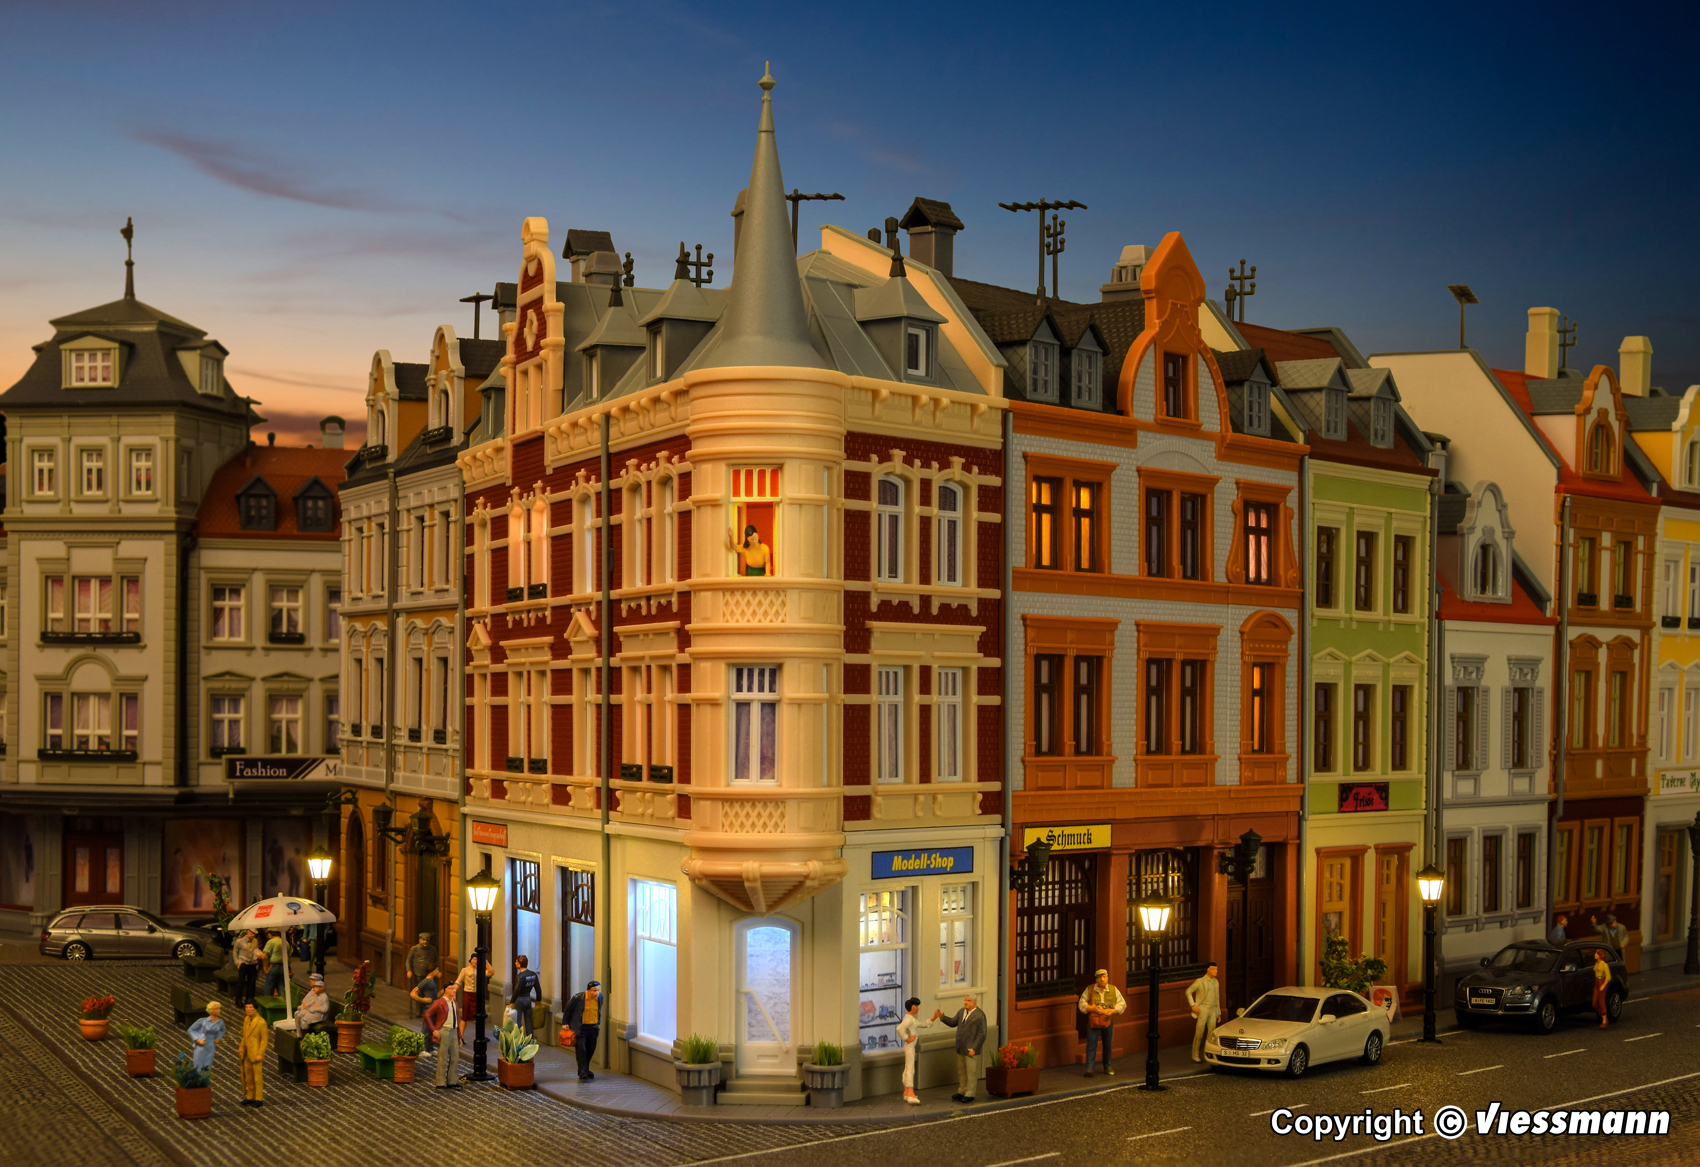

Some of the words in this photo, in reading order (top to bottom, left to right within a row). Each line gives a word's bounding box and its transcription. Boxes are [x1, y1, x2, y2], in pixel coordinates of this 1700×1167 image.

[235, 761, 287, 776] Fashion
[1661, 773, 1686, 788] Taverne
[1353, 792, 1374, 809] Frisör
[1045, 828, 1092, 849] Schmuck
[891, 852, 954, 872] Modell-Shop
